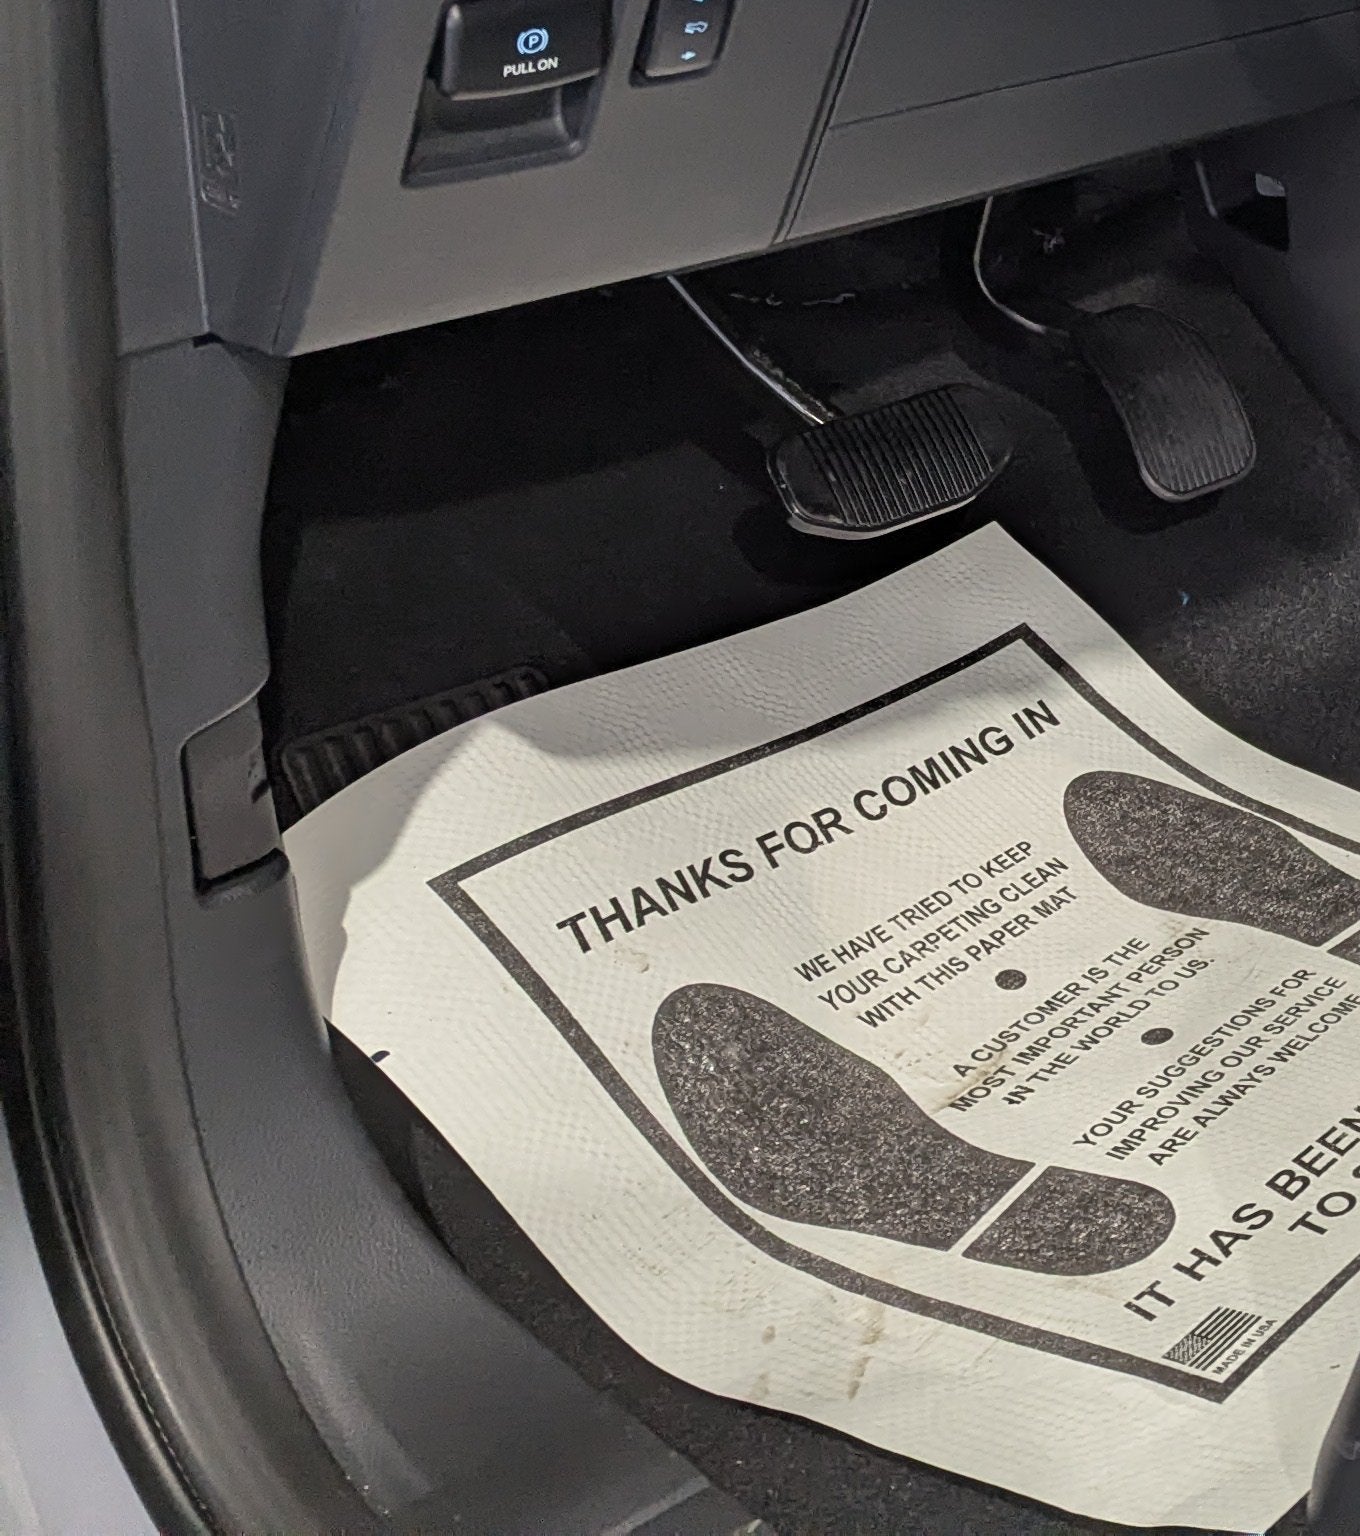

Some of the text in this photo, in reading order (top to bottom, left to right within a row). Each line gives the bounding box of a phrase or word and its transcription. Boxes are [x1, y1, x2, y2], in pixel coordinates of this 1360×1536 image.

[503, 56, 559, 78] PULL ON
[556, 699, 1060, 953] THANKS FOR COMING IN
[793, 841, 1032, 982] WE HAVE TRIED TO KEEP
[817, 857, 1069, 1012] YOUR CARPETING CLEAN
[856, 886, 1078, 1028] WITH THIS PAPER MAT
[950, 927, 1210, 1112] MOST IMPORTANT PERSON
[952, 937, 1150, 1078] A CUSTOMER IS THE
[1001, 958, 1215, 1106] IN THE WORLD TO US.
[1073, 969, 1317, 1148] YOUR SUGGESTIONS FOR
[1105, 977, 1347, 1161] IMPROVING OUR SERVICE
[1148, 1127, 1200, 1166] ARE
[1192, 1064, 1276, 1128] ALWAYS
[1123, 1280, 1176, 1322] IT
[1172, 1202, 1274, 1282] HAS
[1287, 1191, 1357, 1235] TO
[1212, 1319, 1278, 1375] MADE IN USA
